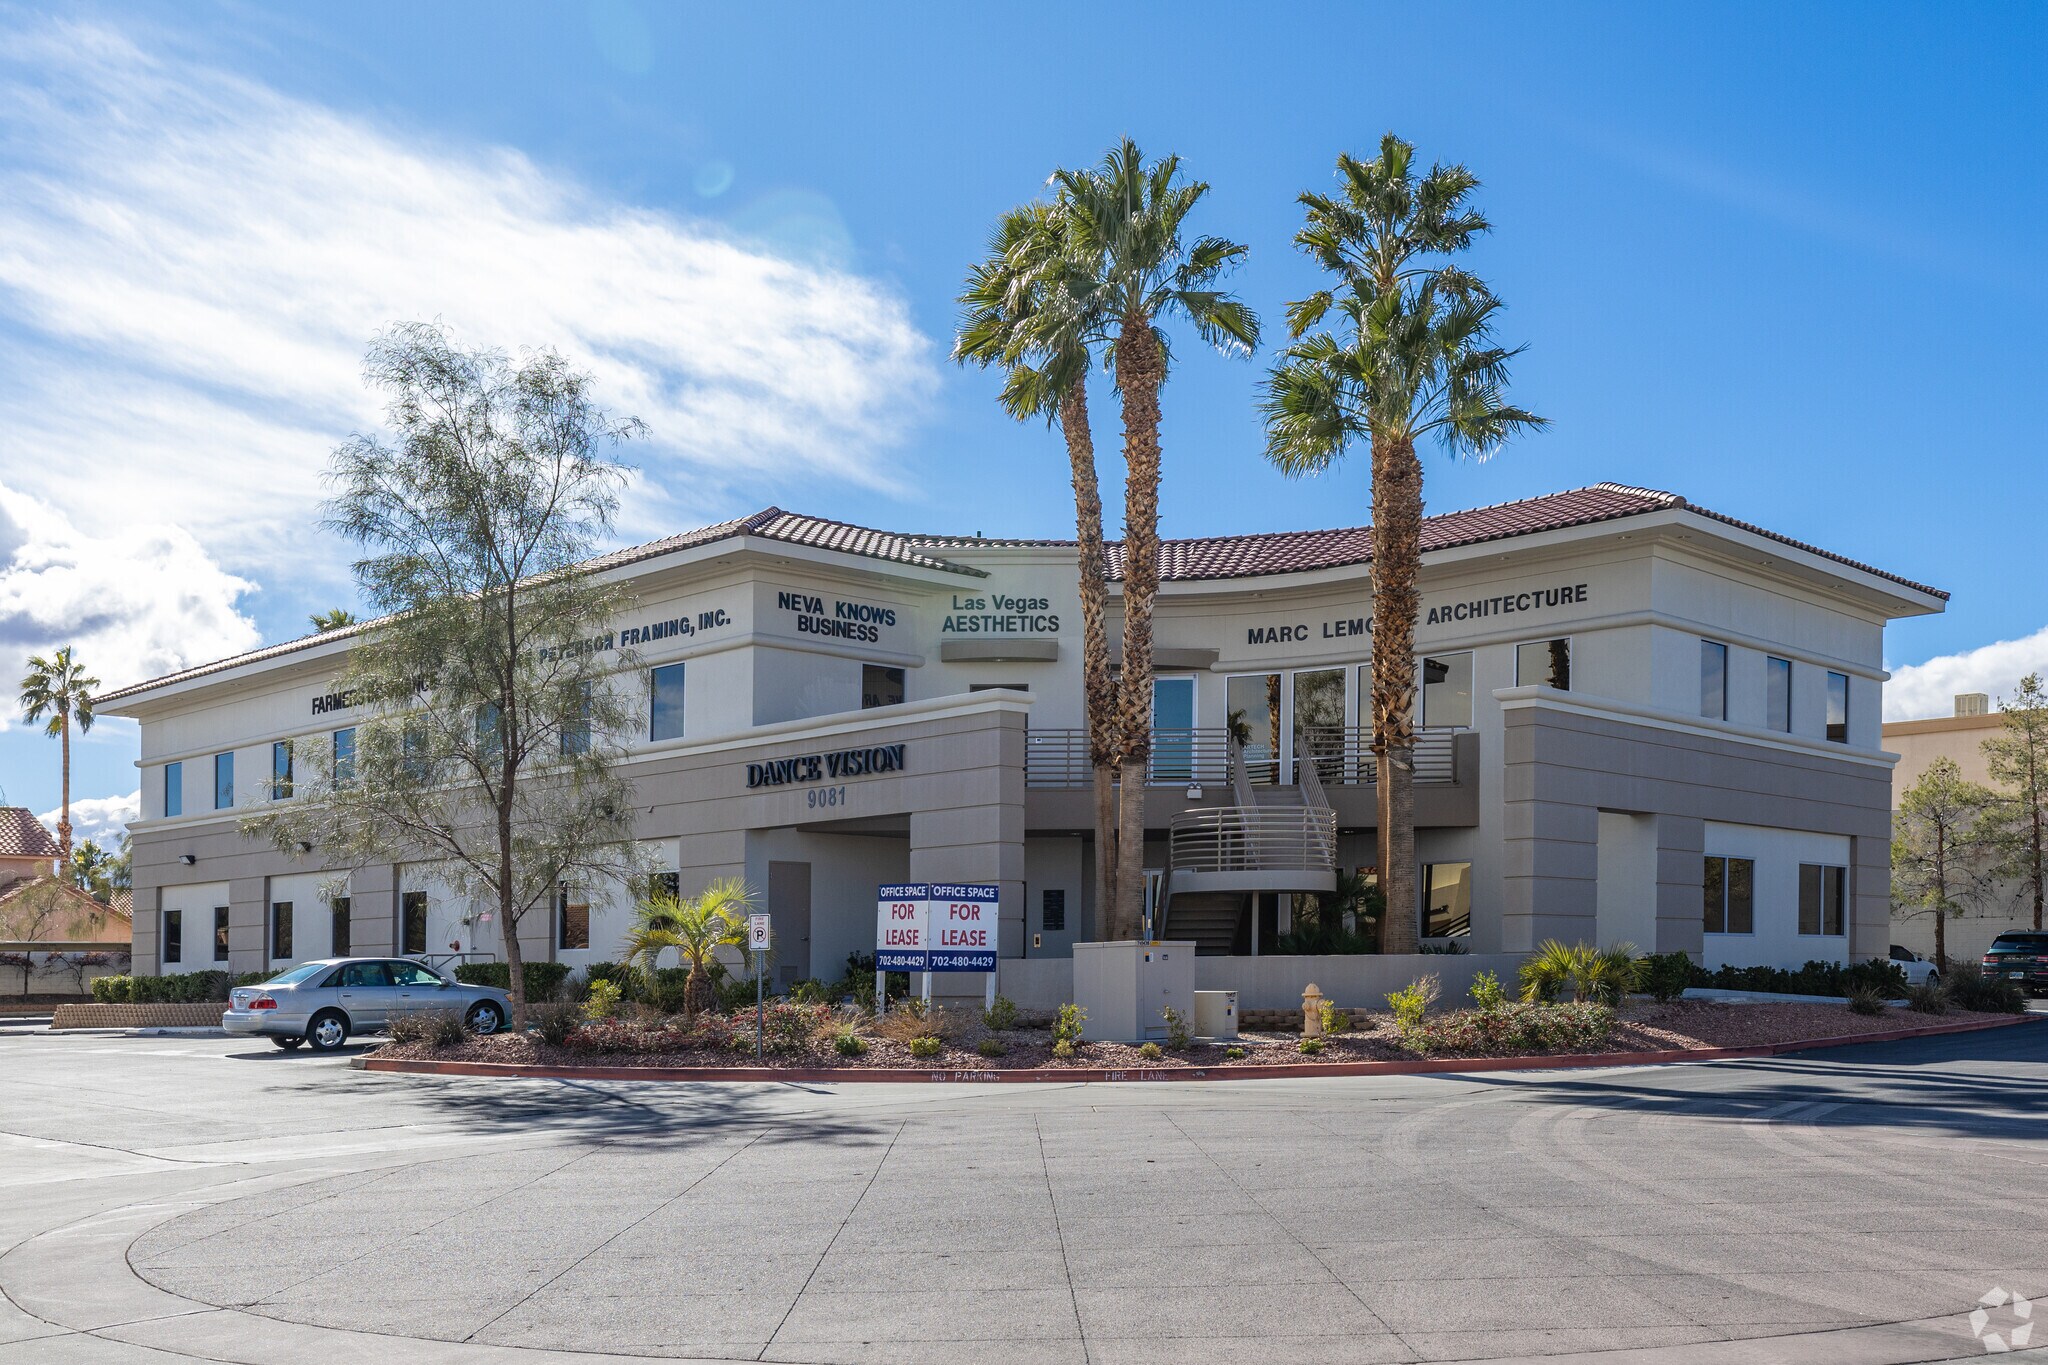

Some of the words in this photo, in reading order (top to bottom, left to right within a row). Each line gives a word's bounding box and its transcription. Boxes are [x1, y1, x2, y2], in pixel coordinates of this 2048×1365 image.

[778, 591, 825, 616] NEVA
[835, 601, 896, 627] KNOWS
[952, 595, 986, 610] Las
[992, 595, 1050, 614] Vegas
[1248, 624, 1309, 644] MARC
[1427, 584, 1589, 625] ARCHITECTURE
[621, 617, 695, 647] FRAMING,
[698, 608, 731, 630] INC.
[797, 614, 879, 643] BUSINESS
[942, 615, 1060, 633] AESTHETICS
[746, 754, 822, 788] DANCE
[824, 744, 906, 778] VISION
[807, 786, 846, 809] 9081
[880, 886, 903, 897] OFFICE
[905, 886, 926, 896] SPACE
[933, 886, 966, 897] OFFICE
[967, 887, 995, 898] SPACE
[891, 904, 915, 920] FOR
[950, 904, 980, 920] FOR
[886, 929, 919, 946] LEASE
[941, 930, 987, 946] LEASE
[879, 956, 925, 966] 702-480-4429
[932, 956, 994, 967] 702-480-4429
[931, 1071, 946, 1081] NO
[954, 1071, 1000, 1081] PARKING
[1105, 1071, 1128, 1081] FIRE
[1140, 1071, 1168, 1081] LANE
